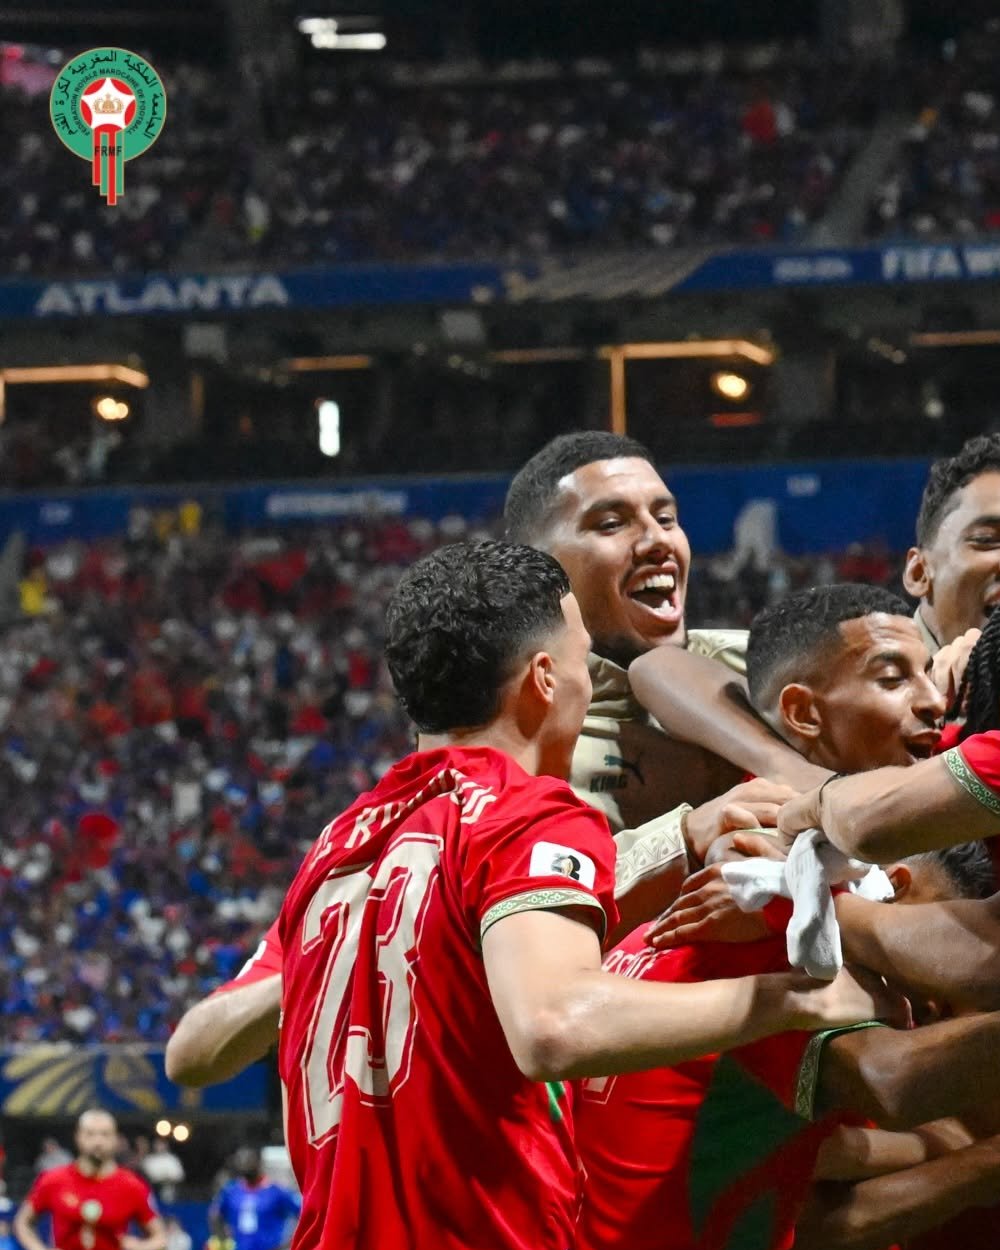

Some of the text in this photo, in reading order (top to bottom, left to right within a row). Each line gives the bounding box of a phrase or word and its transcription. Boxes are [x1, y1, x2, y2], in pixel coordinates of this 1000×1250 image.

[882, 246, 961, 281] FIFA
[35, 276, 288, 316] ATLANTA
[302, 832, 444, 1150] 23
